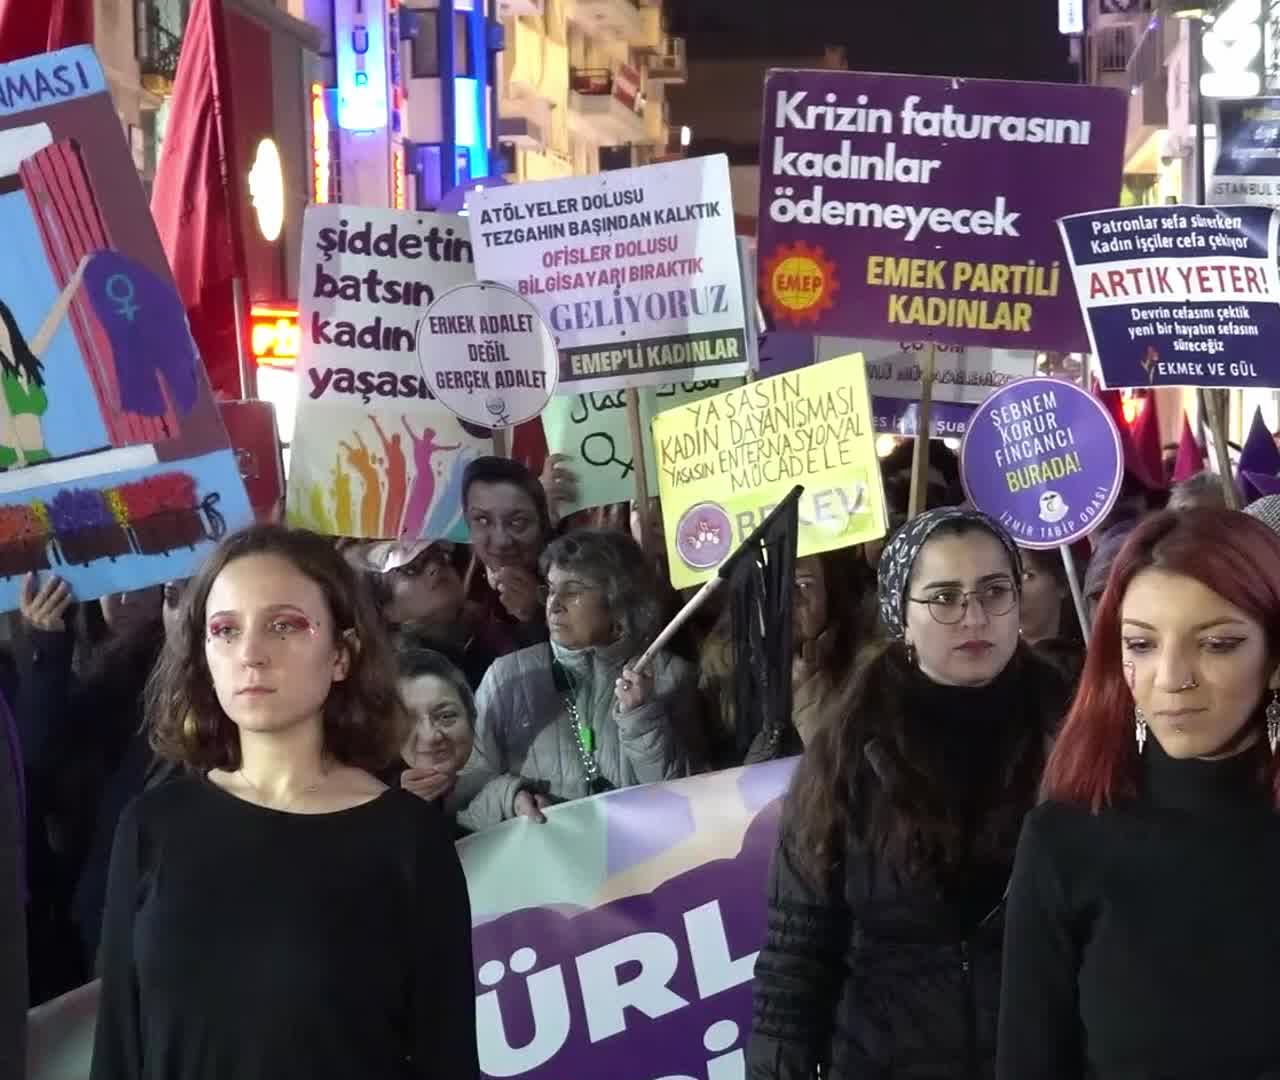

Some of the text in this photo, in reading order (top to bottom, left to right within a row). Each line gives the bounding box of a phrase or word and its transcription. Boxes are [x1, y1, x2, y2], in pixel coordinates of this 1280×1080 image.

[775, 90, 1091, 145] Krizin faturasını
[773, 136, 941, 184] kadınlar
[480, 188, 644, 225] ATÖLYELER DOLUSU
[482, 201, 721, 248] TEZGAHIN BAŞINDAN KALKTIK
[770, 185, 1020, 241] ödemeyecek
[1091, 214, 1242, 235] Patronlar sefa sürerken
[316, 219, 474, 264] şiddetin
[542, 235, 679, 268] OFİSLER DOLUSU
[1090, 233, 1248, 254] Kadın işçiler cefa çekiyor
[313, 263, 435, 306] batsın
[518, 257, 704, 296] BİLGİSAYARI BIRAKTIK
[776, 273, 823, 292] EMEP
[866, 256, 1061, 297] EMEK PARTİLİ
[1089, 265, 1270, 299] ARTIK YETER!
[429, 314, 534, 335] ERKEK ADALET
[550, 283, 729, 333] GELİYORUZ
[887, 295, 1033, 333] KADINLAR
[1131, 306, 1250, 322] Devrin cefasını çektik
[311, 311, 420, 352] kadın
[1128, 323, 1259, 340] yeni bir hayatın sefasını
[1173, 339, 1225, 354] süreceğiz
[468, 340, 510, 363] DEĞİL
[571, 337, 740, 376] EMEP'Lİ KADINLAR
[1158, 361, 1257, 377] EKMEK VE GÜL
[435, 370, 547, 393] GERÇEK ADALET
[661, 424, 720, 465] KADIN
[999, 412, 1057, 446] KORUR
[1006, 451, 1082, 493] BURADA!
[1080, 487, 1108, 523] ODASI
